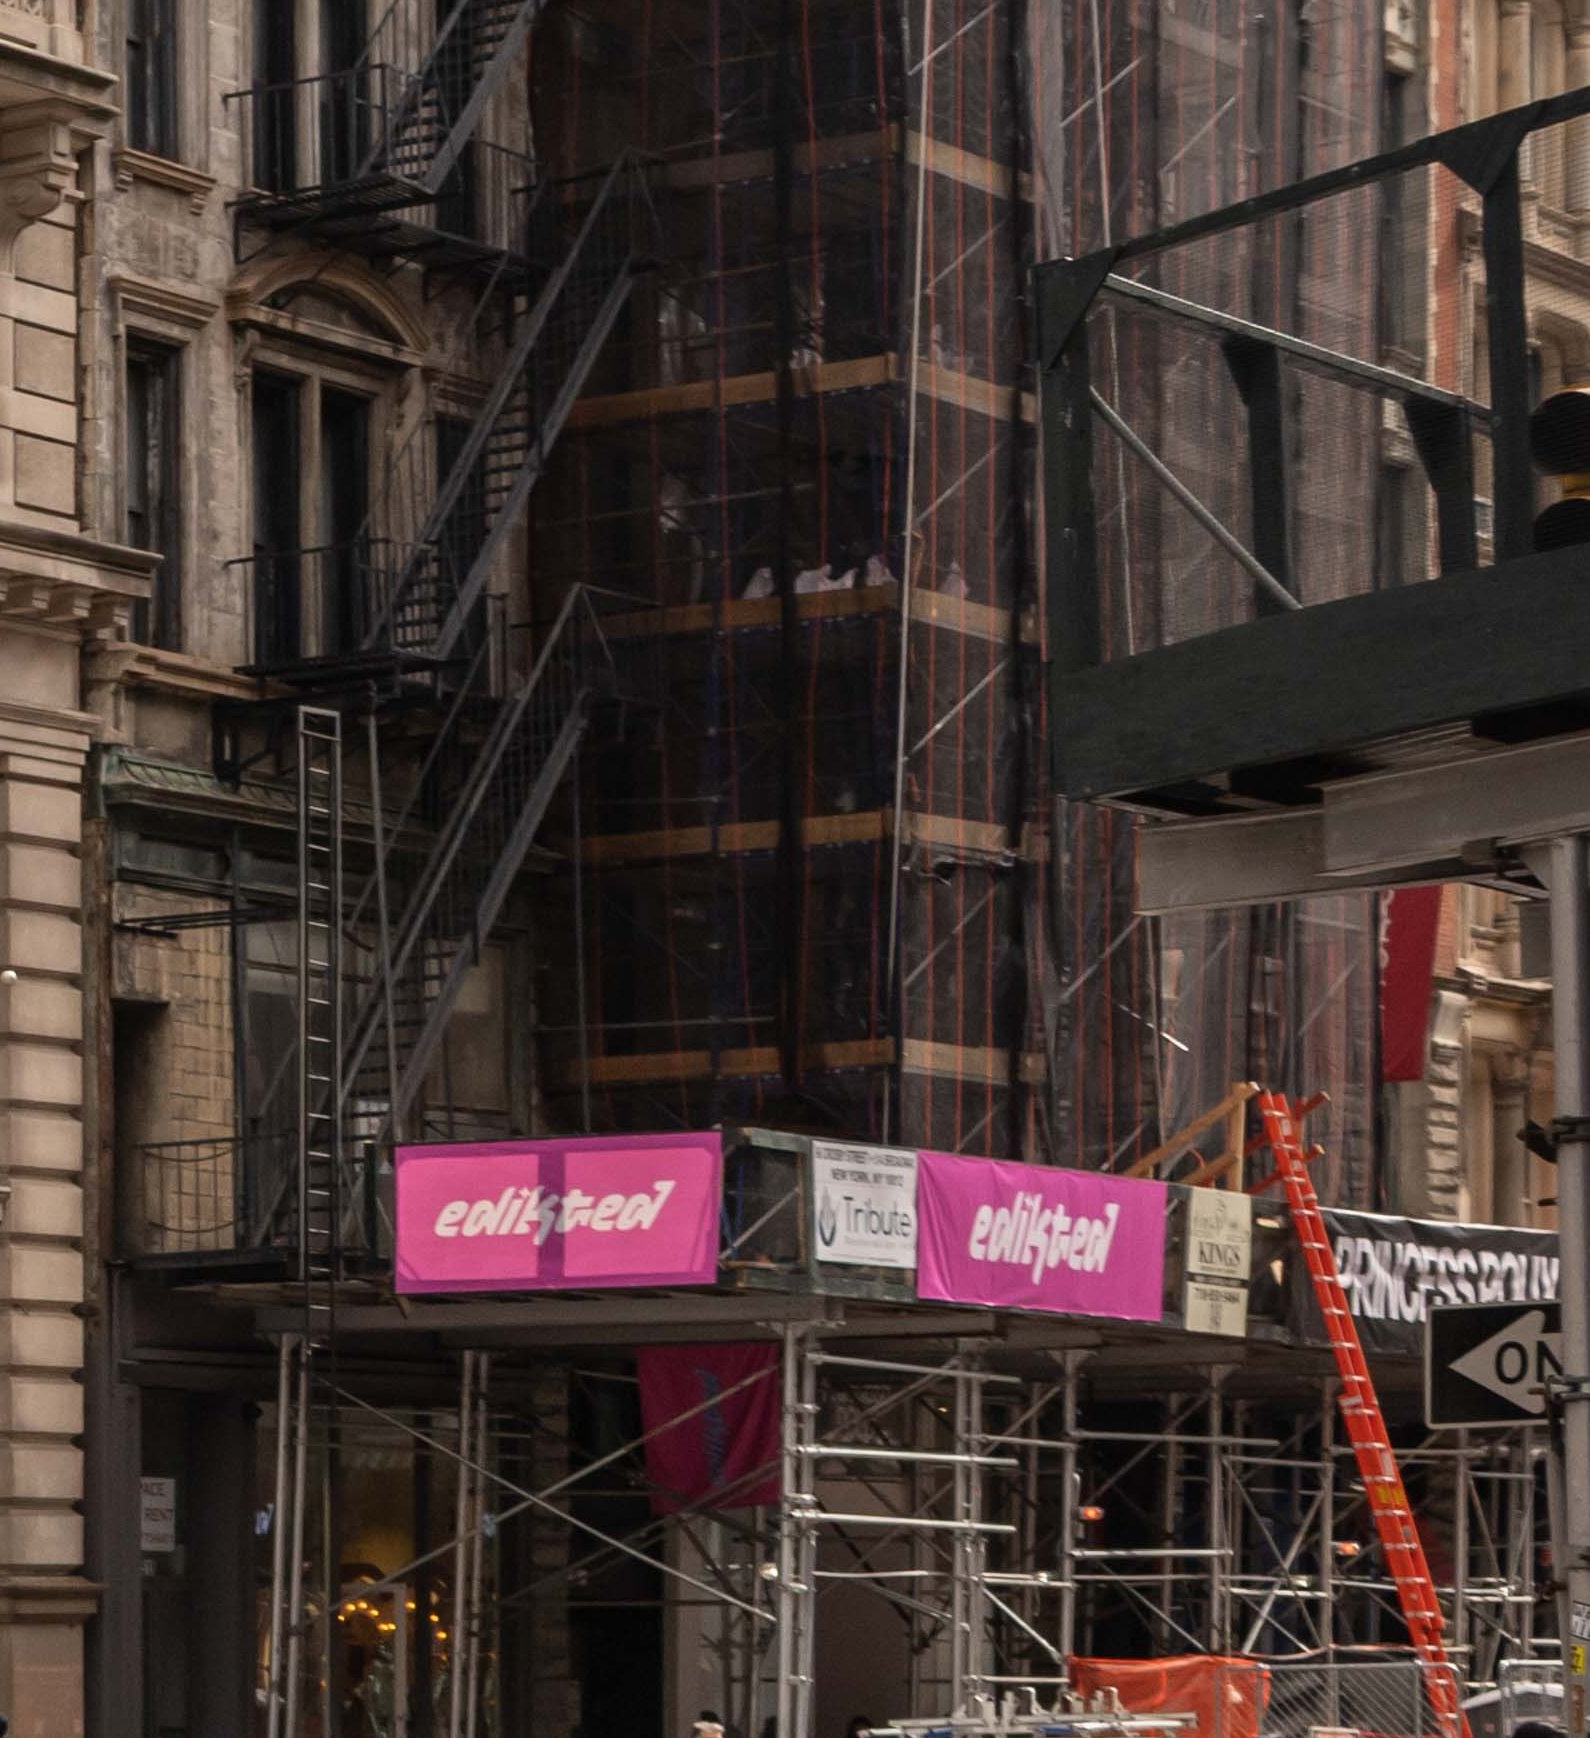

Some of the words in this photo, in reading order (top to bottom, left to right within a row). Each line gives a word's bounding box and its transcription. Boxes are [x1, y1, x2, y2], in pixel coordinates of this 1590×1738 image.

[843, 1196, 911, 1238] Tribute
[1198, 1240, 1240, 1268] KINGS
[1336, 1235, 1478, 1323] PRINCESS
[1495, 1340, 1564, 1385] ON
